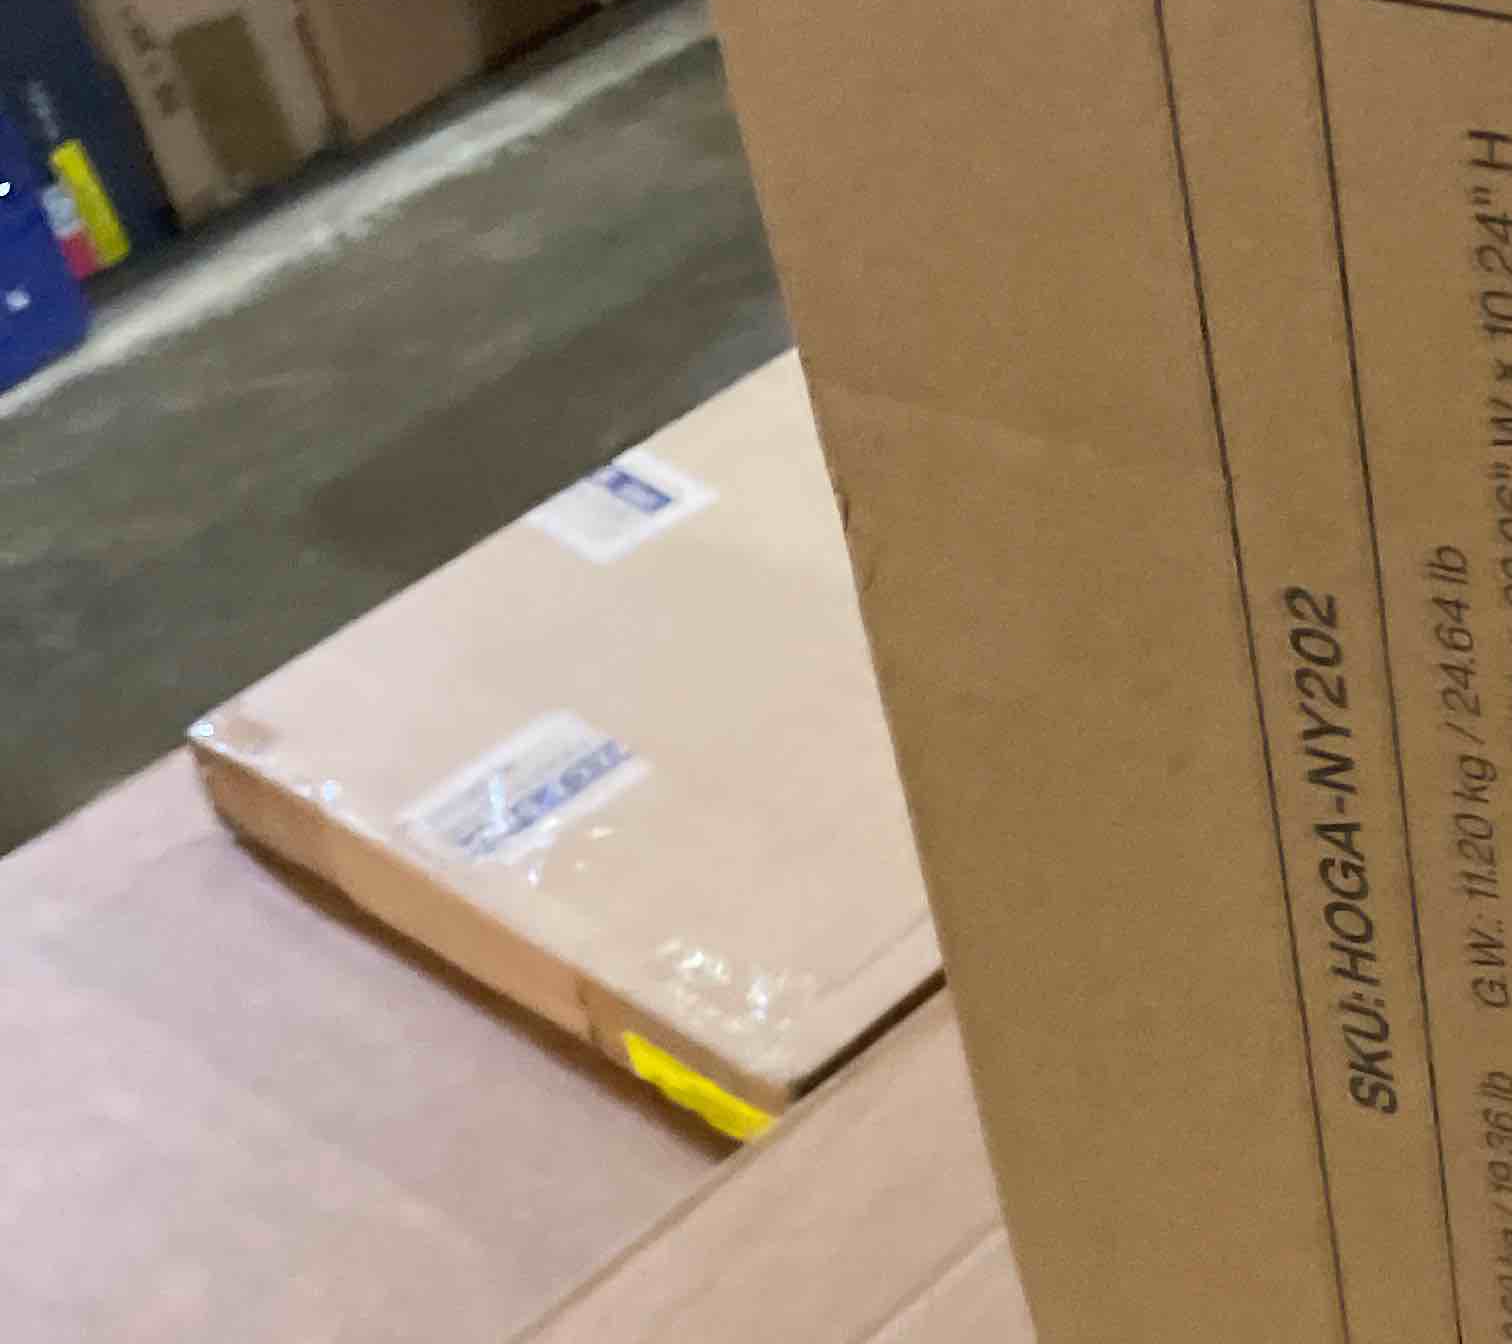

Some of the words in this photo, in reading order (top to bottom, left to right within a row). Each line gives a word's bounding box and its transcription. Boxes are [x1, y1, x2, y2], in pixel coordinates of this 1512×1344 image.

[1426, 543, 1468, 583] lb
[1430, 595, 1482, 716] 24.64
[1445, 719, 1484, 745] /
[1451, 754, 1497, 802] kg
[1453, 811, 1500, 900] 11.20
